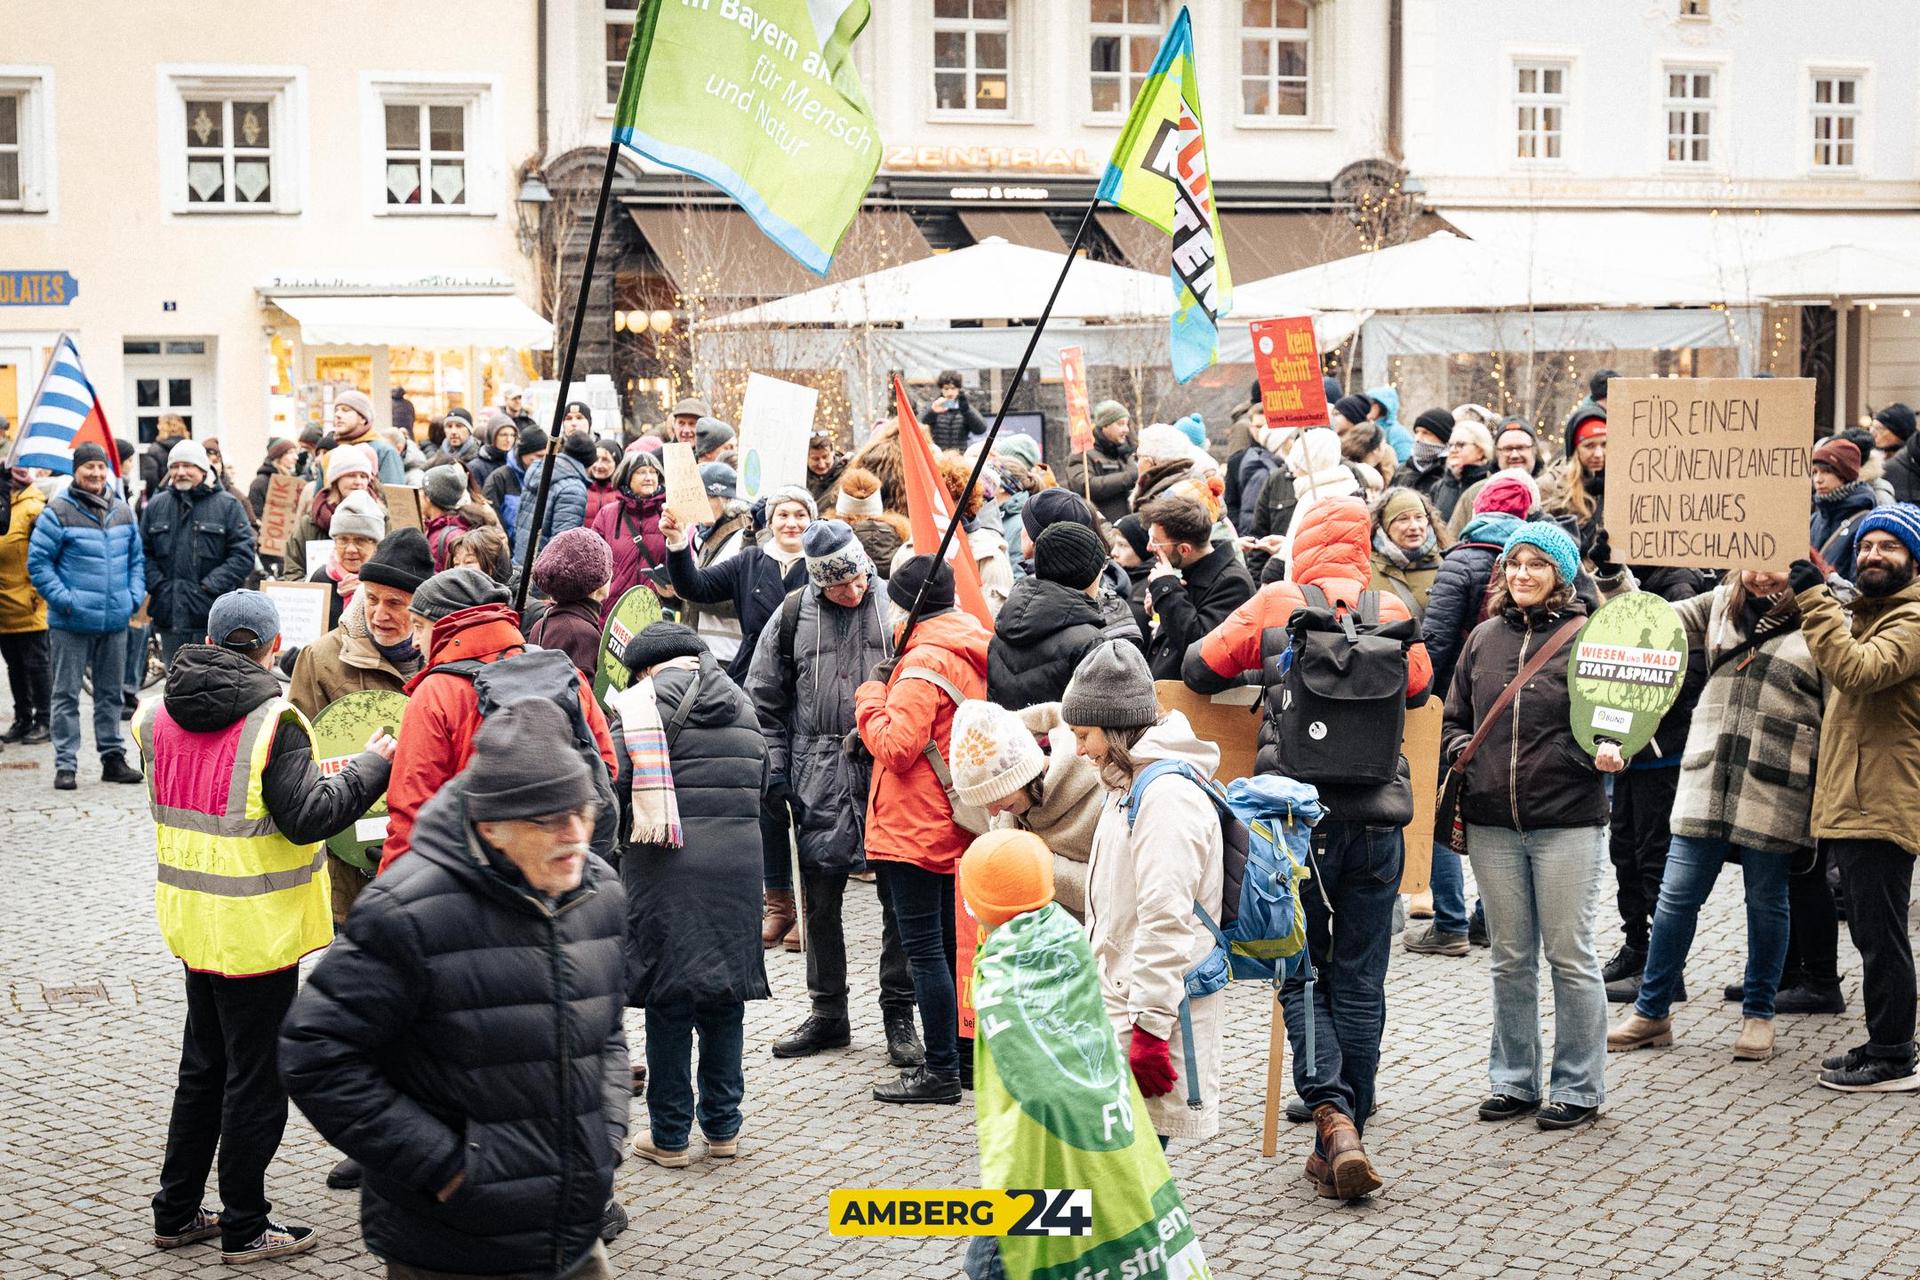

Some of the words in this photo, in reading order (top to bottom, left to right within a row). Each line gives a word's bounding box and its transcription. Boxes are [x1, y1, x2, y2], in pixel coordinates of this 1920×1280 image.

[719, 0, 798, 61] Bayern
[704, 73, 755, 113] und
[755, 99, 809, 158] Natur
[750, 53, 782, 91] für
[782, 79, 872, 154] Mensch
[887, 145, 1092, 174] ZENTRAL
[1285, 327, 1314, 355] kein
[1271, 355, 1312, 384] Schritt
[1264, 383, 1304, 412] zurück
[1632, 395, 1683, 439] FÜR
[1688, 398, 1760, 435] EINEN
[1629, 445, 1724, 484] GRÜNEN
[1725, 446, 1814, 480] PLANETEN
[265, 478, 292, 552] POLITIK
[1629, 492, 1672, 526] KEIN
[1680, 493, 1746, 523] BLAUES
[1630, 529, 1776, 561] DEUTSCHLAND
[1581, 646, 1627, 661] WIESEN
[1642, 652, 1678, 666] WALD
[1578, 662, 1617, 678] STATT
[1615, 665, 1674, 684] ASPHALT
